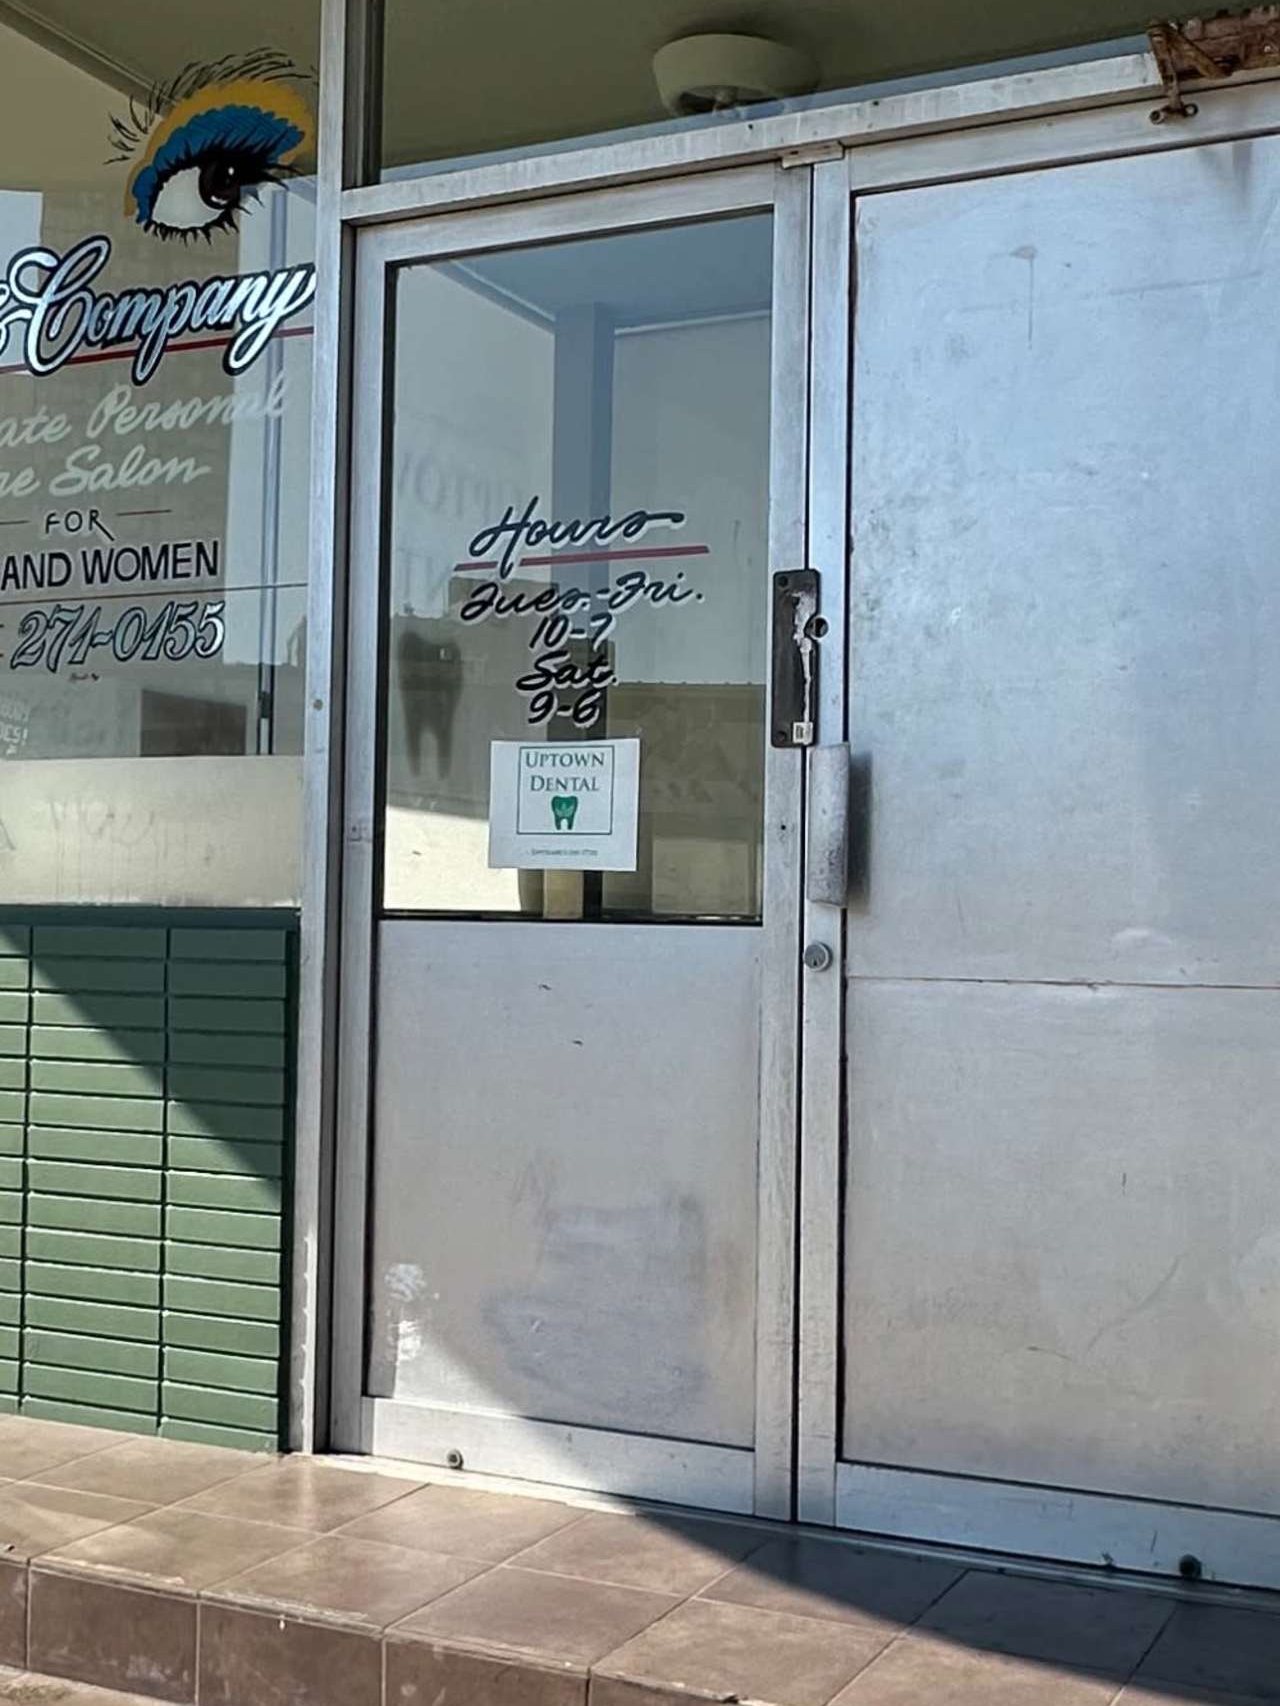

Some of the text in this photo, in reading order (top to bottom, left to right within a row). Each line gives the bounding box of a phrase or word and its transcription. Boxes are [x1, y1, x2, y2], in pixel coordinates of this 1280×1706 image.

[7, 234, 317, 387] Company
[86, 370, 287, 440] Personal
[49, 445, 212, 497] Salon
[44, 508, 116, 542] FOR
[468, 495, 686, 580] Hours
[0, 551, 72, 592] AND
[82, 540, 220, 585] WOMEN
[10, 600, 226, 674] 271-0155
[529, 613, 614, 649] 10-7
[516, 650, 618, 691] Sat.
[528, 689, 602, 724] 9-6
[525, 751, 606, 769] UPTOWN
[530, 774, 600, 792] DENTAL
